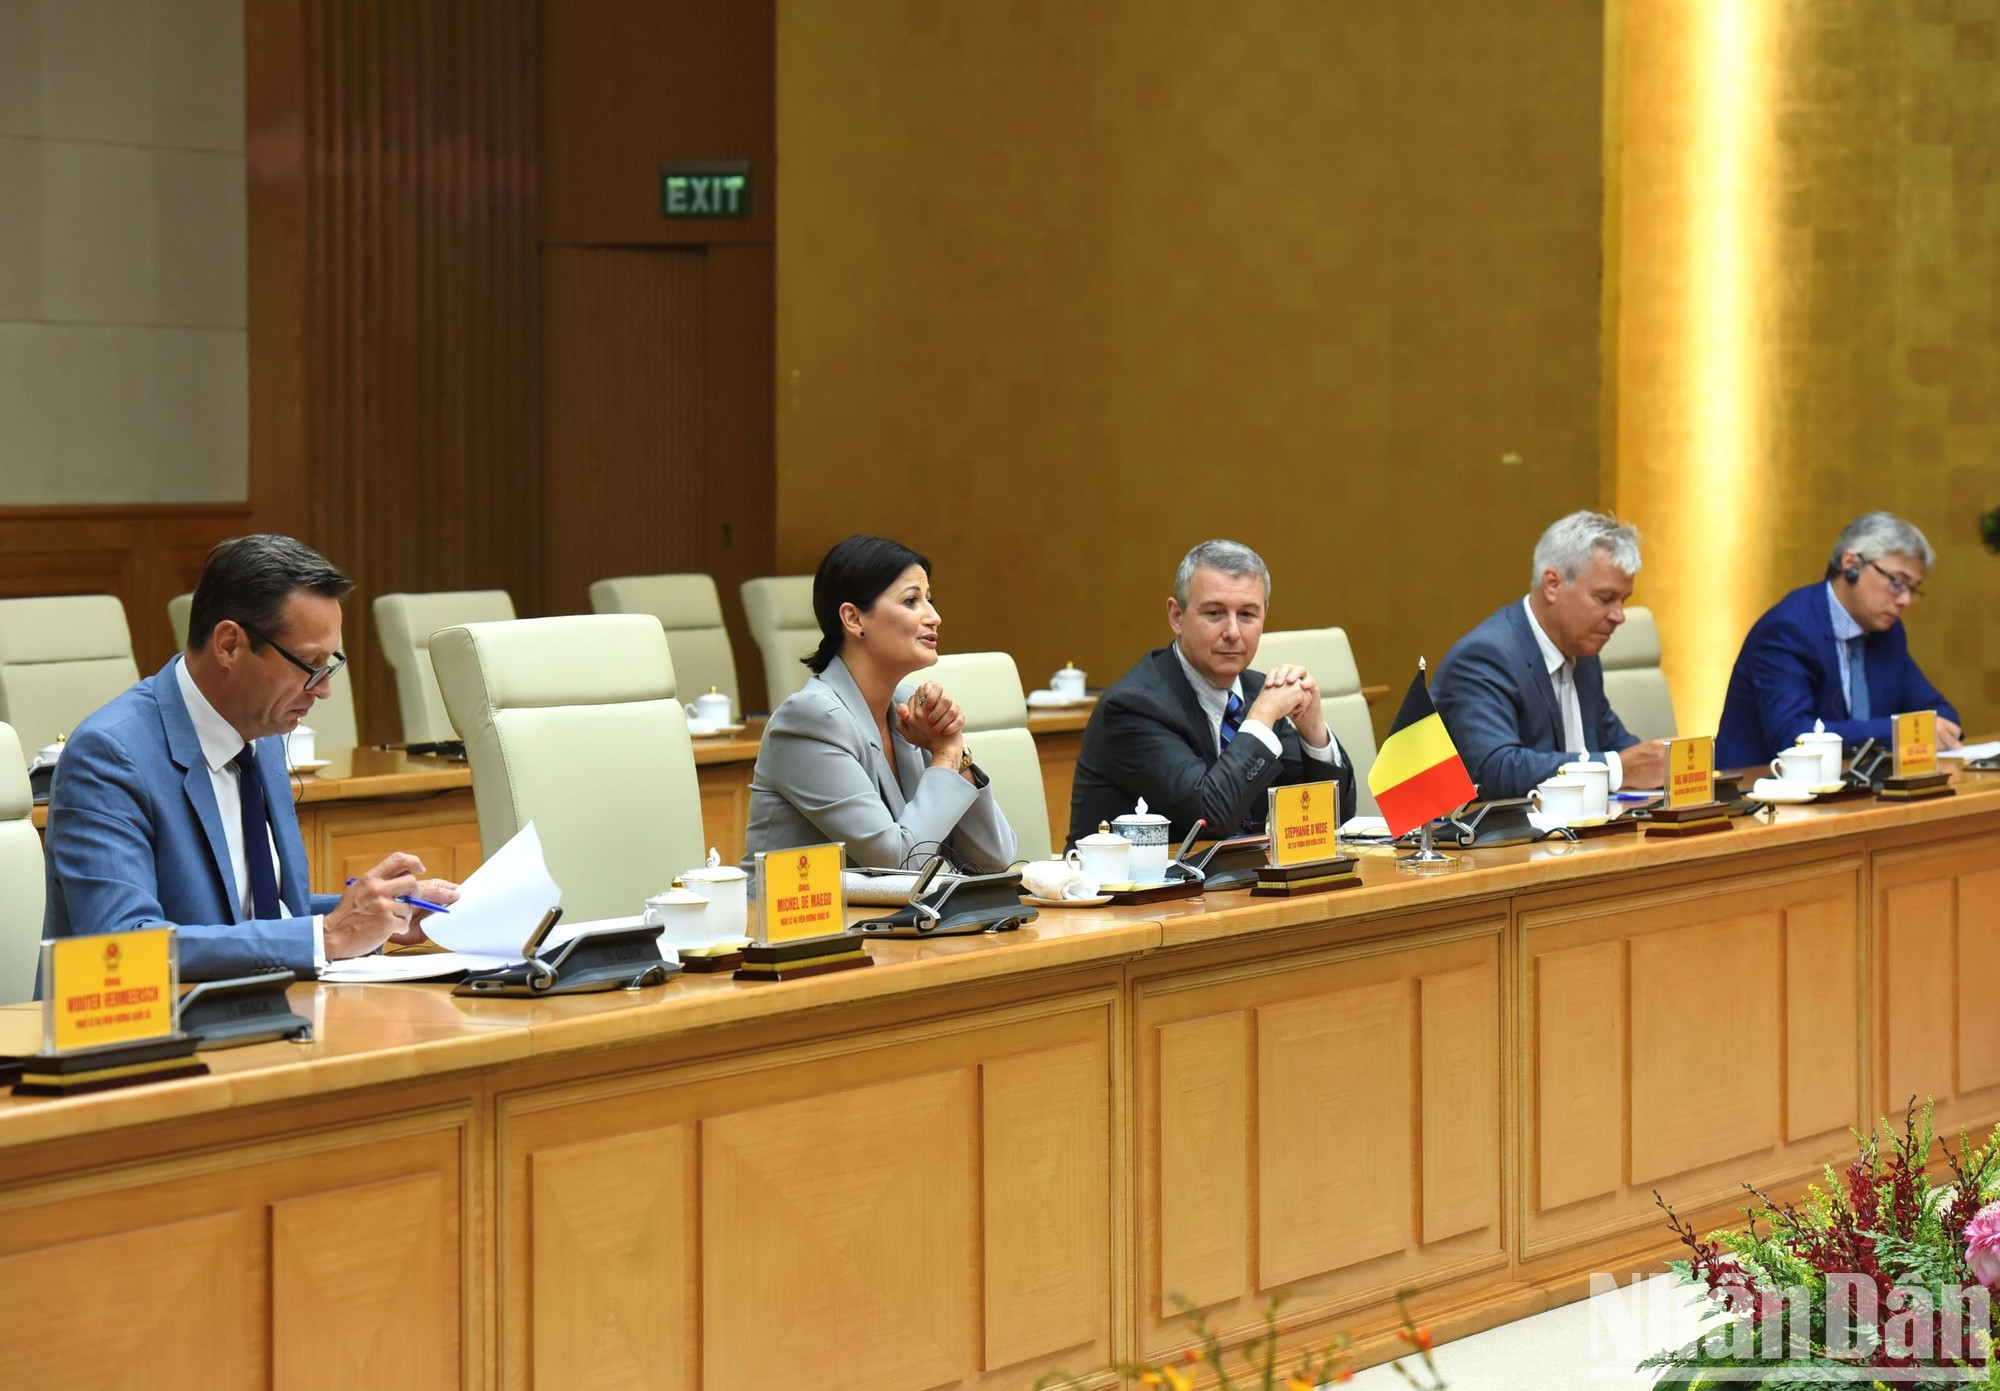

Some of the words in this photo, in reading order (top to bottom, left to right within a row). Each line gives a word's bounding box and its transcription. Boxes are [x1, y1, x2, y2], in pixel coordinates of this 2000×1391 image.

[666, 176, 746, 214] EXIT
[798, 883, 810, 892] ÔNG
[777, 896, 800, 912] MICHEL
[801, 895, 809, 909] DE
[67, 994, 101, 1013] WOUTER
[104, 986, 159, 1008] VERMEERSCH
